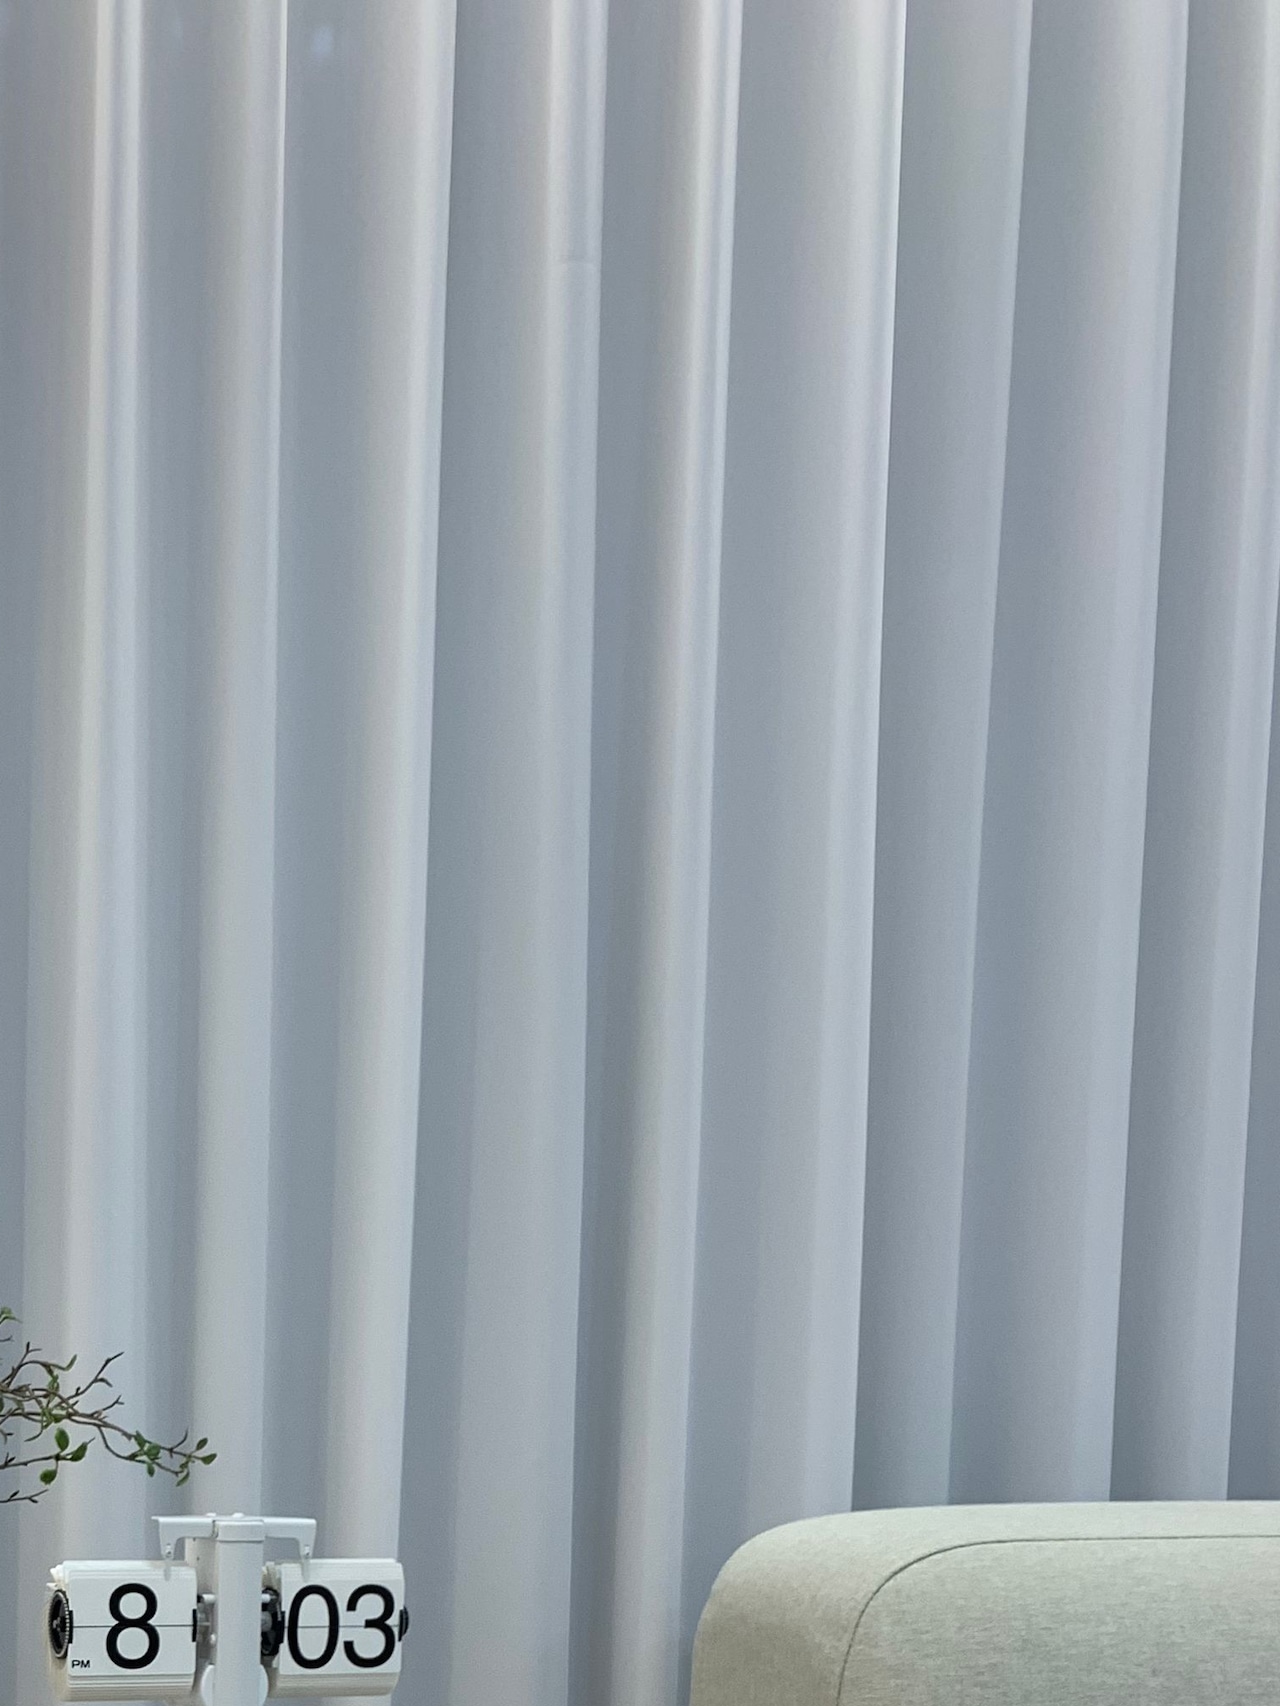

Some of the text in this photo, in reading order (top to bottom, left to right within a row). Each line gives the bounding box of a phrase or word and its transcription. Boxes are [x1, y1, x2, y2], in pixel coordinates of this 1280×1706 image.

[106, 1583, 396, 1669] 8 03
[71, 1659, 91, 1669] PM
